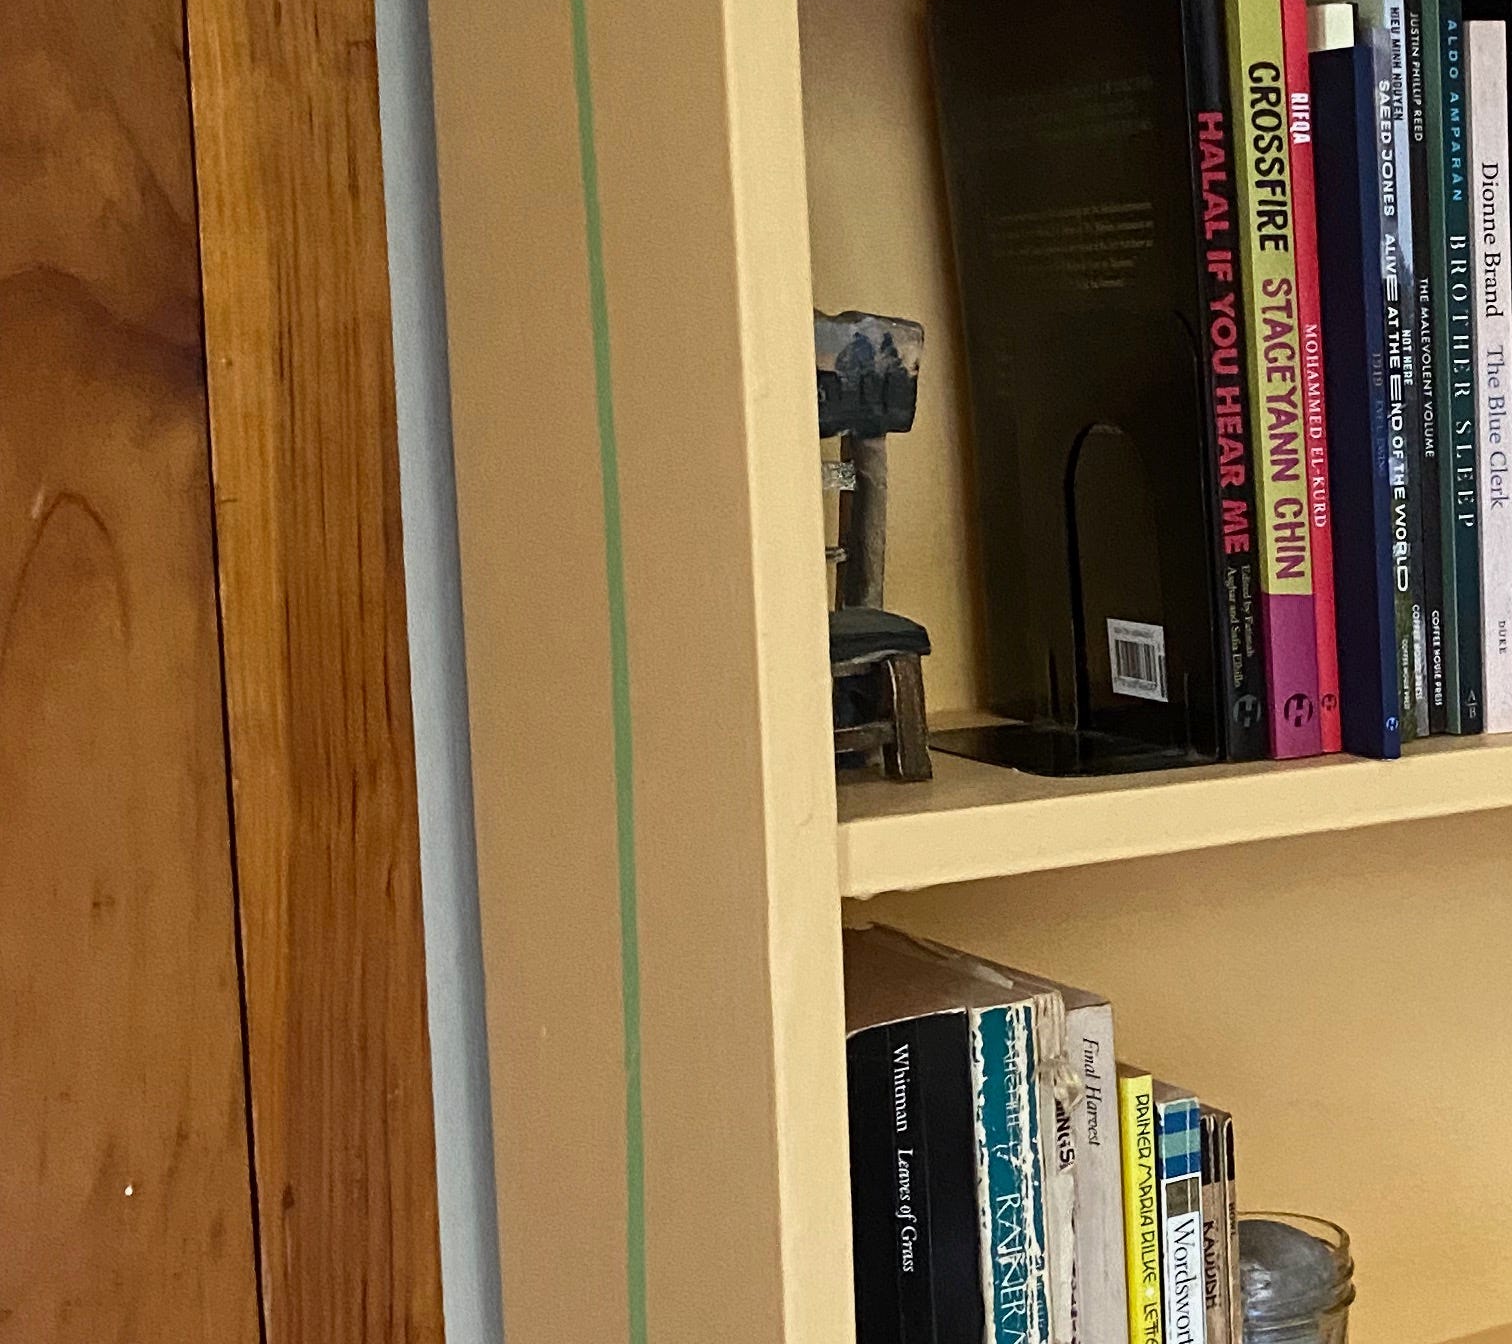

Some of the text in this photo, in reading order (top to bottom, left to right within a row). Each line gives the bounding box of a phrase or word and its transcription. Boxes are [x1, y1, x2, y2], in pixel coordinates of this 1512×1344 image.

[1291, 93, 1310, 144] RIFQA
[1379, 80, 1395, 216] SAEED JONES
[1447, 20, 1464, 202] ALDO AMPARÁN
[1482, 162, 1504, 318] Dionne Brand
[1197, 111, 1249, 554] HALAL IF YOU HEAR ME
[1248, 61, 1305, 579] CROSSFIRE STACEYANN CHIN
[1450, 236, 1474, 528] BROTHER SLEEP
[1304, 324, 1327, 528] MOHAMMED EL-KURD
[1486, 345, 1508, 508] The Blue Clerk
[893, 1044, 917, 1273] Whitman Leaves of Grass
[1083, 1038, 1102, 1146] Final Harvest
[1135, 1094, 1151, 1159] RAINER
[1139, 1163, 1154, 1226] MARIA
[1142, 1231, 1157, 1283] RILKE
